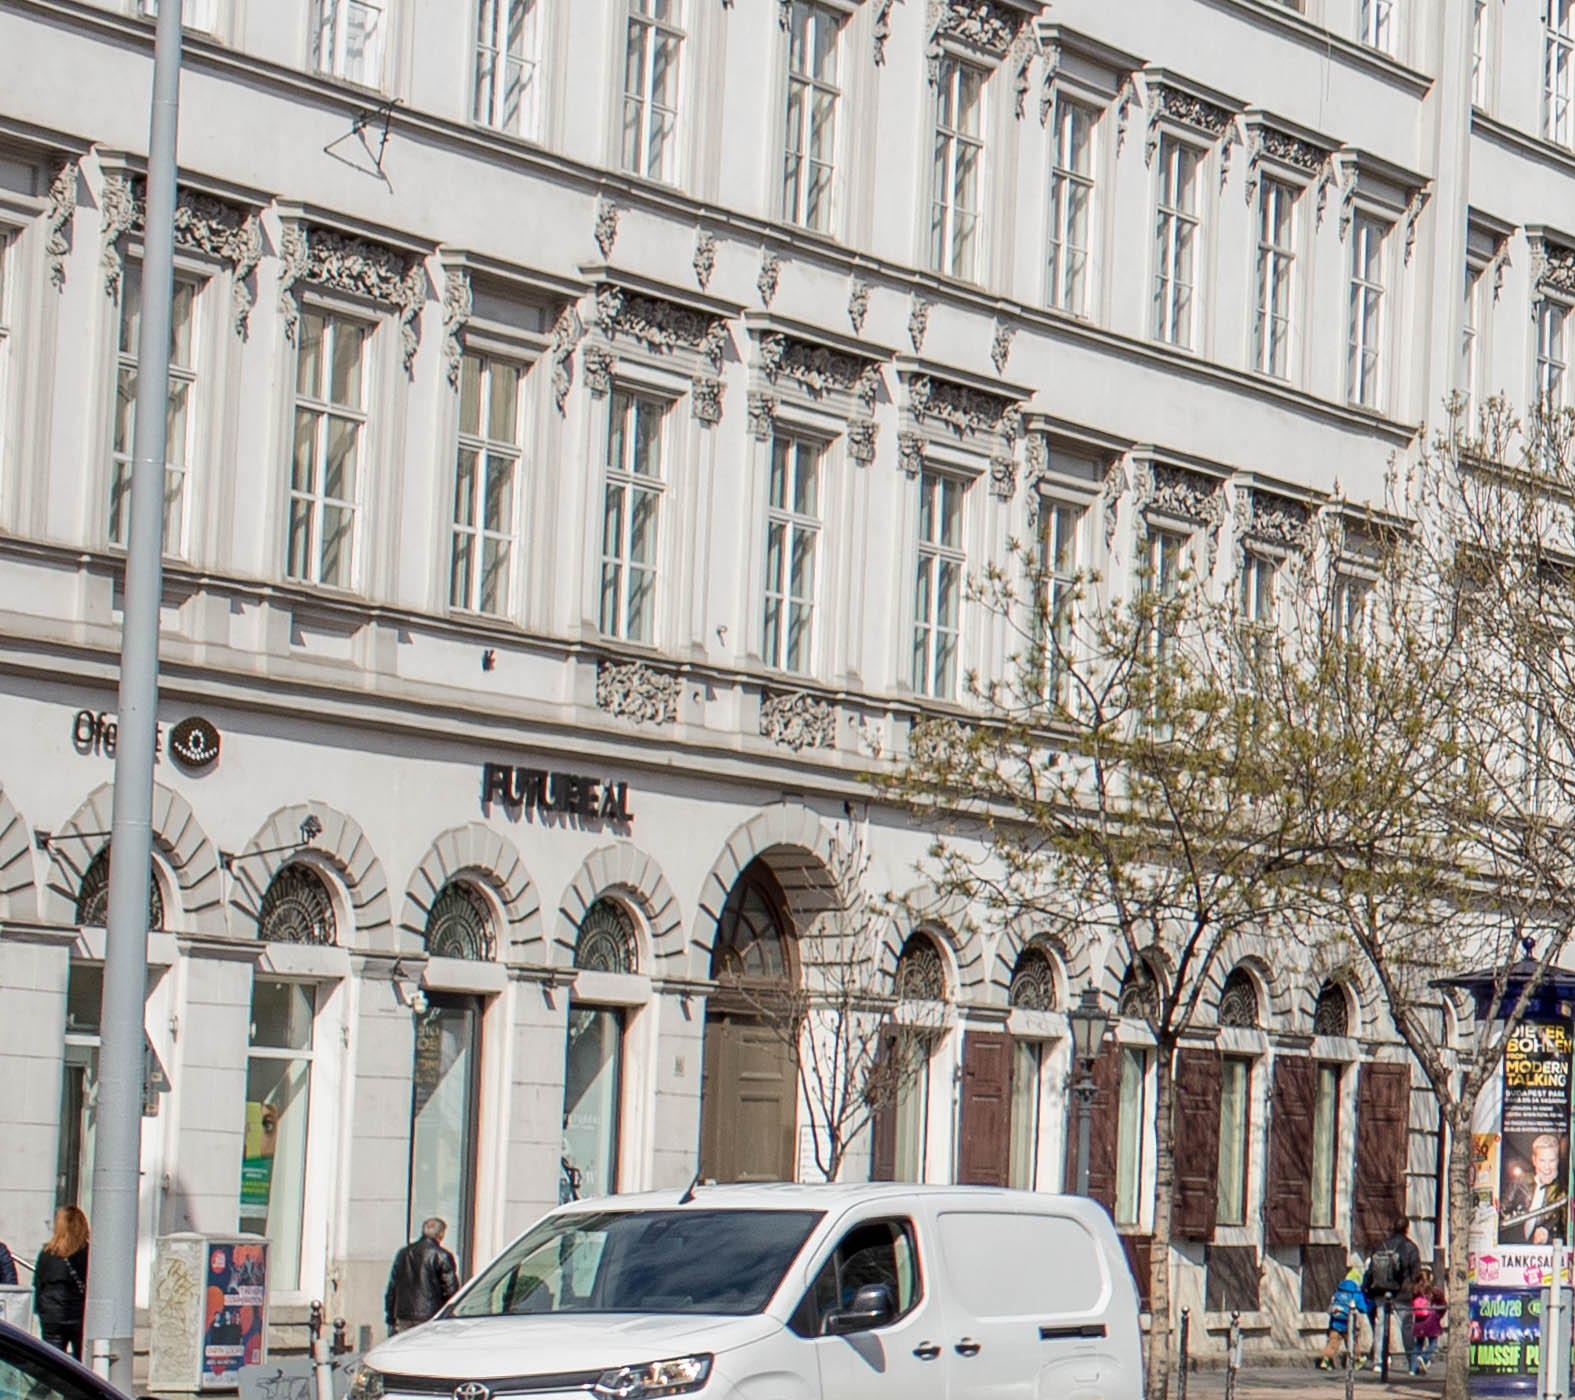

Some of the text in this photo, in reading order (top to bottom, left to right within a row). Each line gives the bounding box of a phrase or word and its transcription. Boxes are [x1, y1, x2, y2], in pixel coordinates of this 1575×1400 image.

[482, 762, 634, 822] FUTUREAL
[1506, 1060, 1569, 1074] MODERN
[1507, 1073, 1567, 1087] TALKING
[1477, 1344, 1521, 1366] MASSIF
